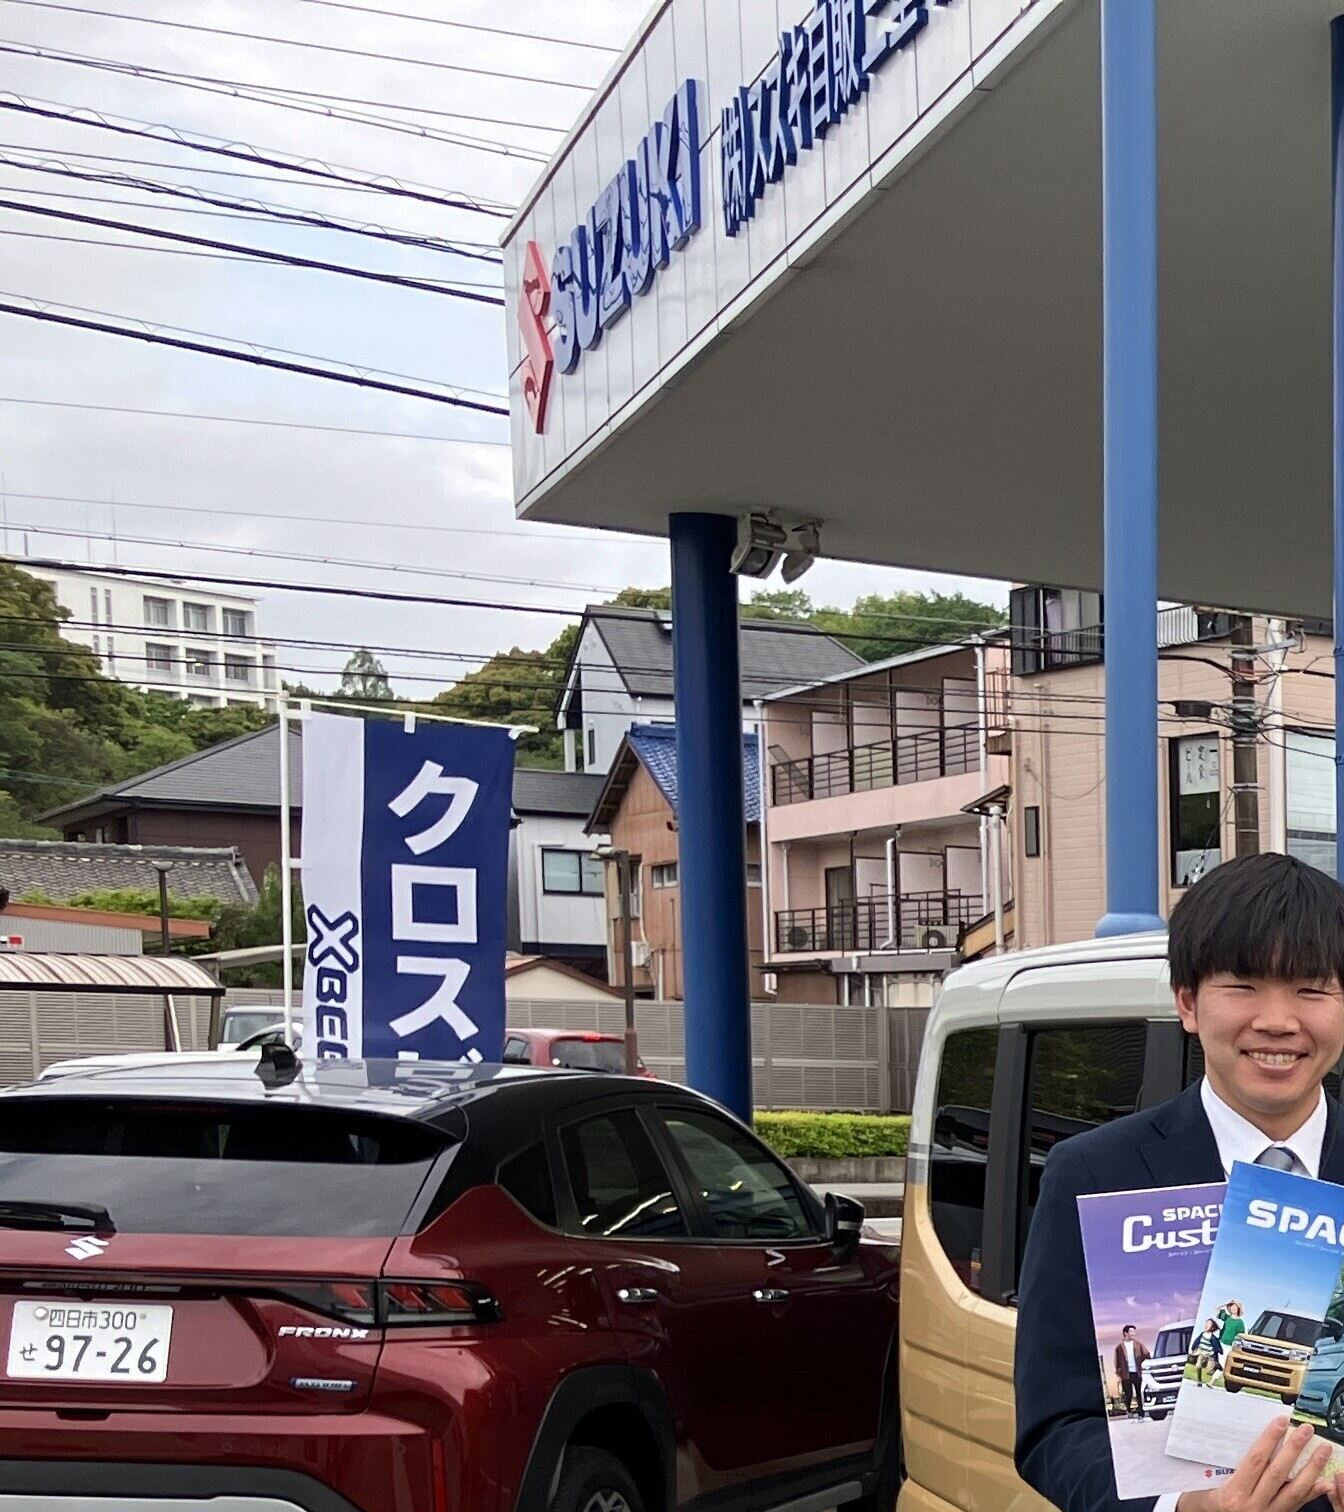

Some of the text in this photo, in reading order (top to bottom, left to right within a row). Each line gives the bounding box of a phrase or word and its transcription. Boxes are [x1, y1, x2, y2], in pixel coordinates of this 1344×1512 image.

[550, 77, 700, 375] SUZUKI
[388, 760, 484, 1062] クロス
[20, 1335, 160, 1375] せ 97-26
[278, 1325, 370, 1340] FRONX
